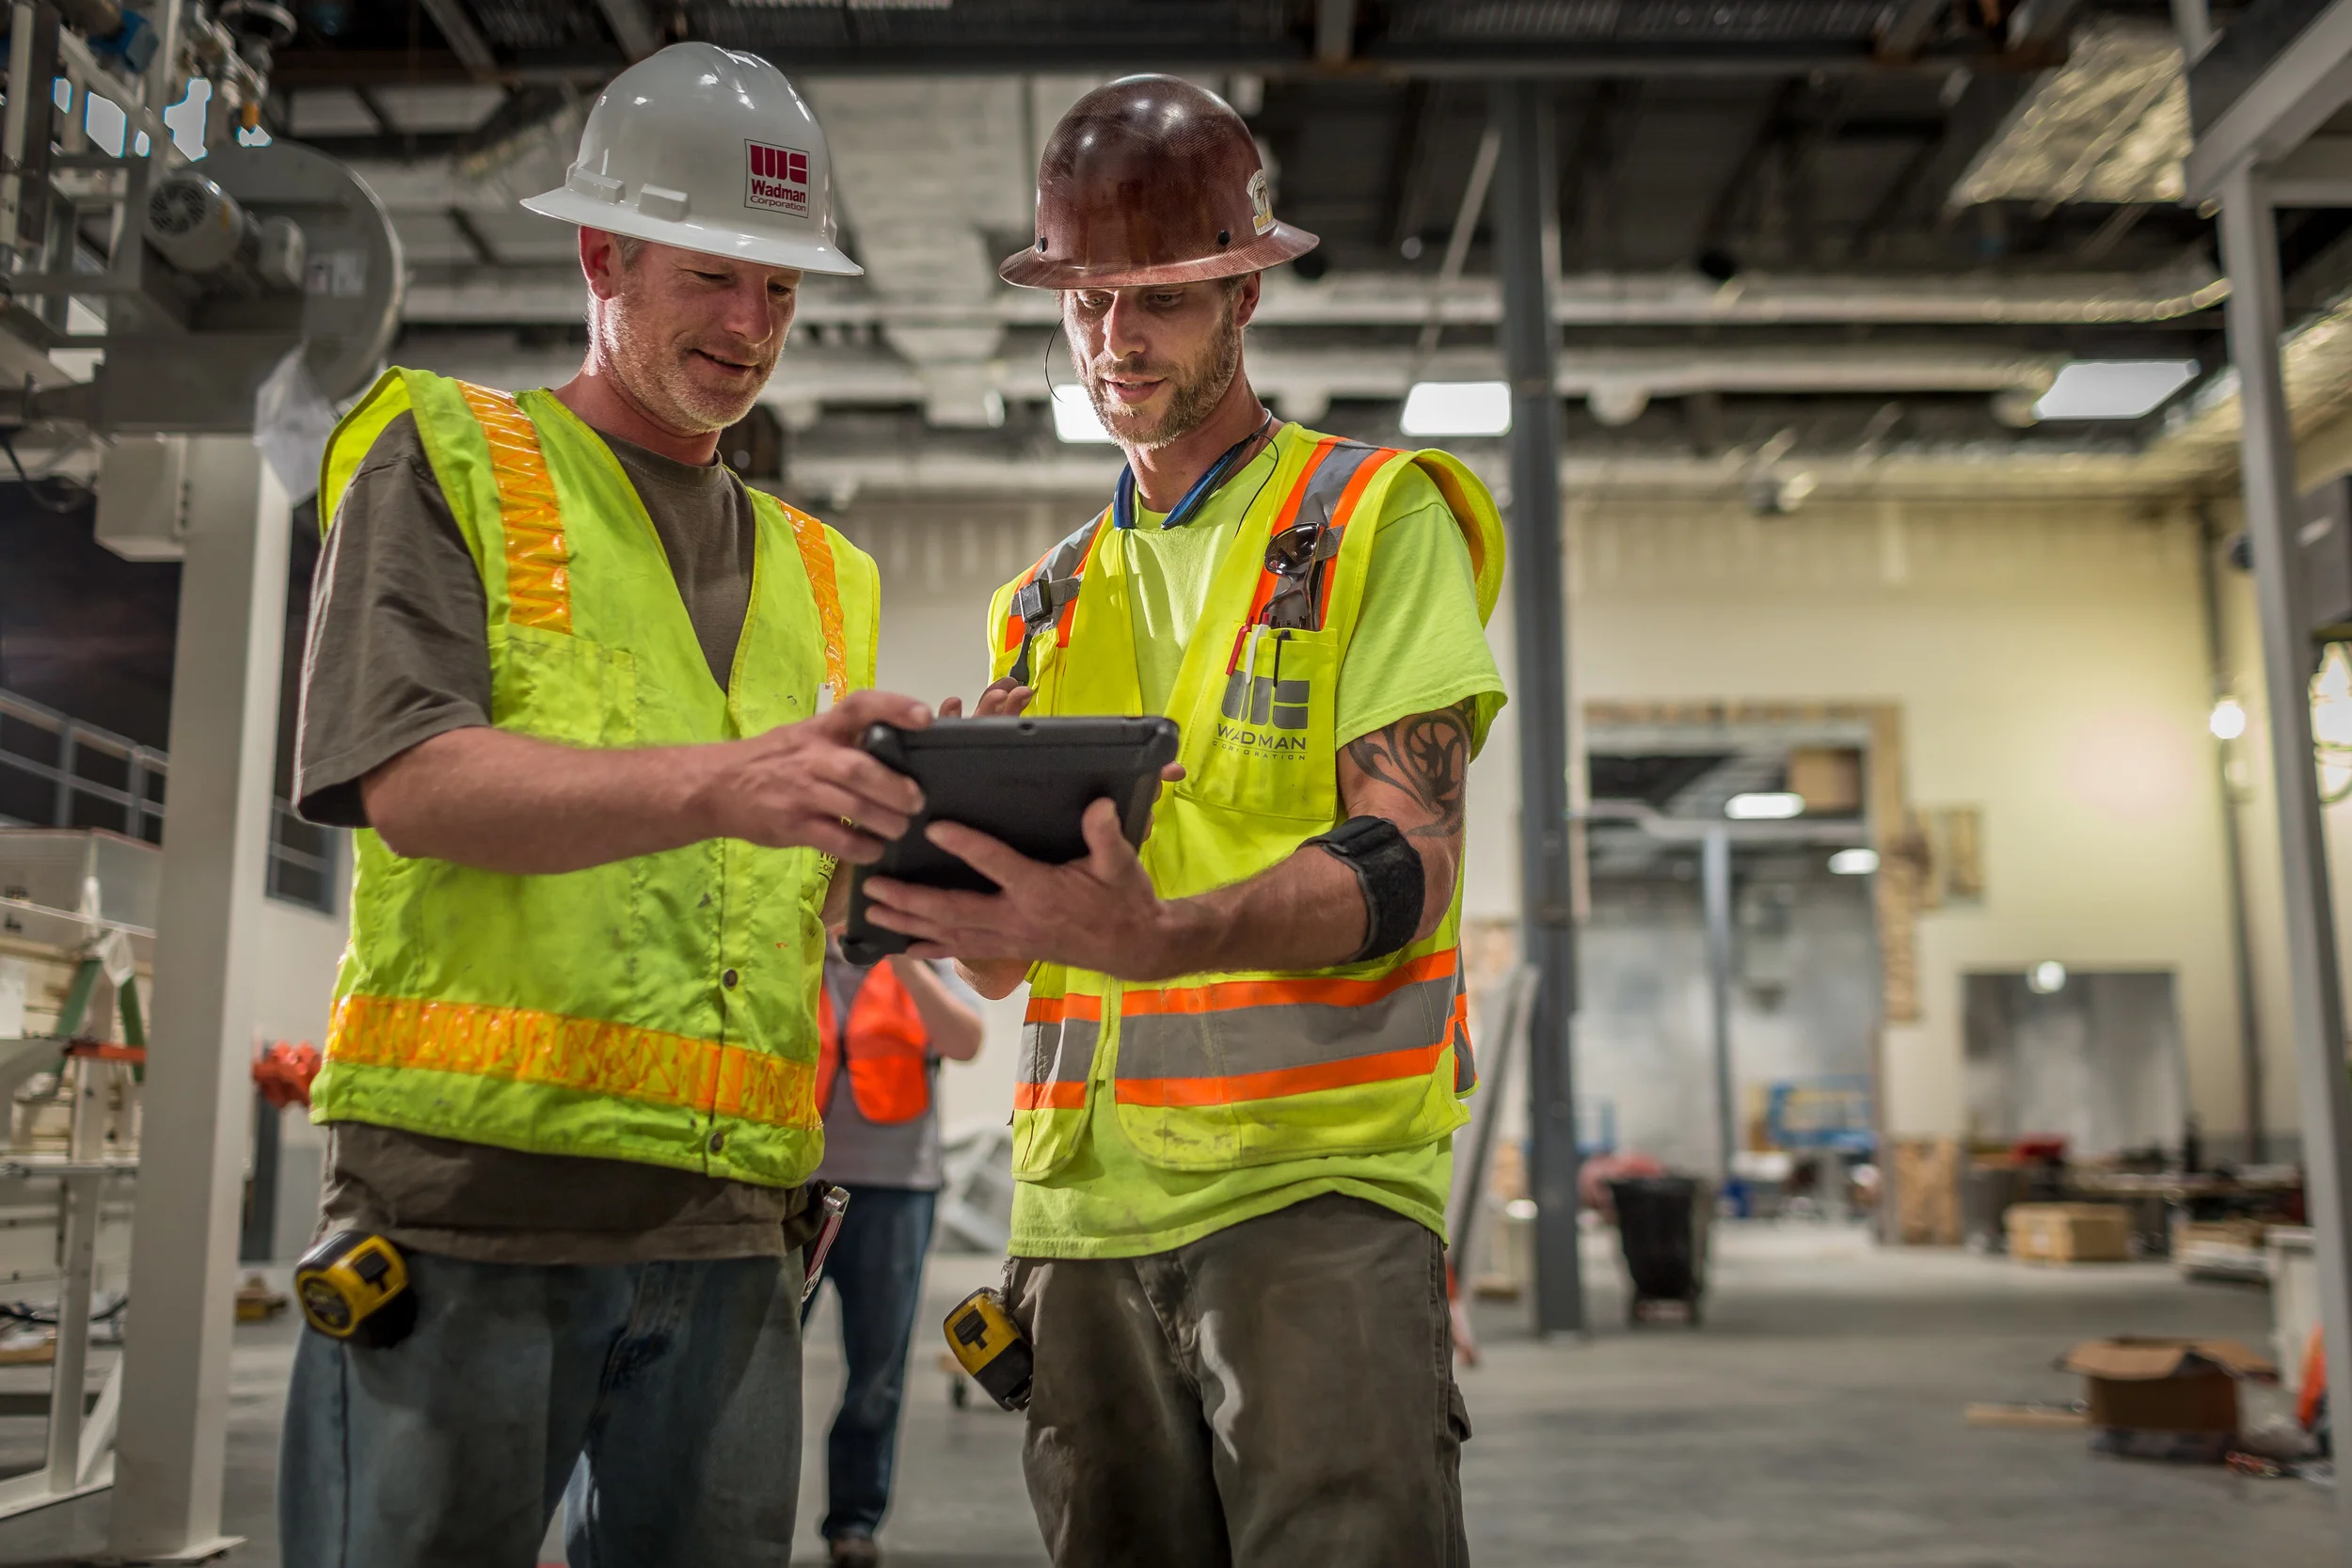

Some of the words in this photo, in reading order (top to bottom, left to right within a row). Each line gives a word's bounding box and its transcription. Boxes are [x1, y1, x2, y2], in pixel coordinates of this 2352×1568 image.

[751, 178, 806, 203] Wadman
[750, 195, 806, 213] Corporation
[1217, 722, 1307, 750] WADMAN
